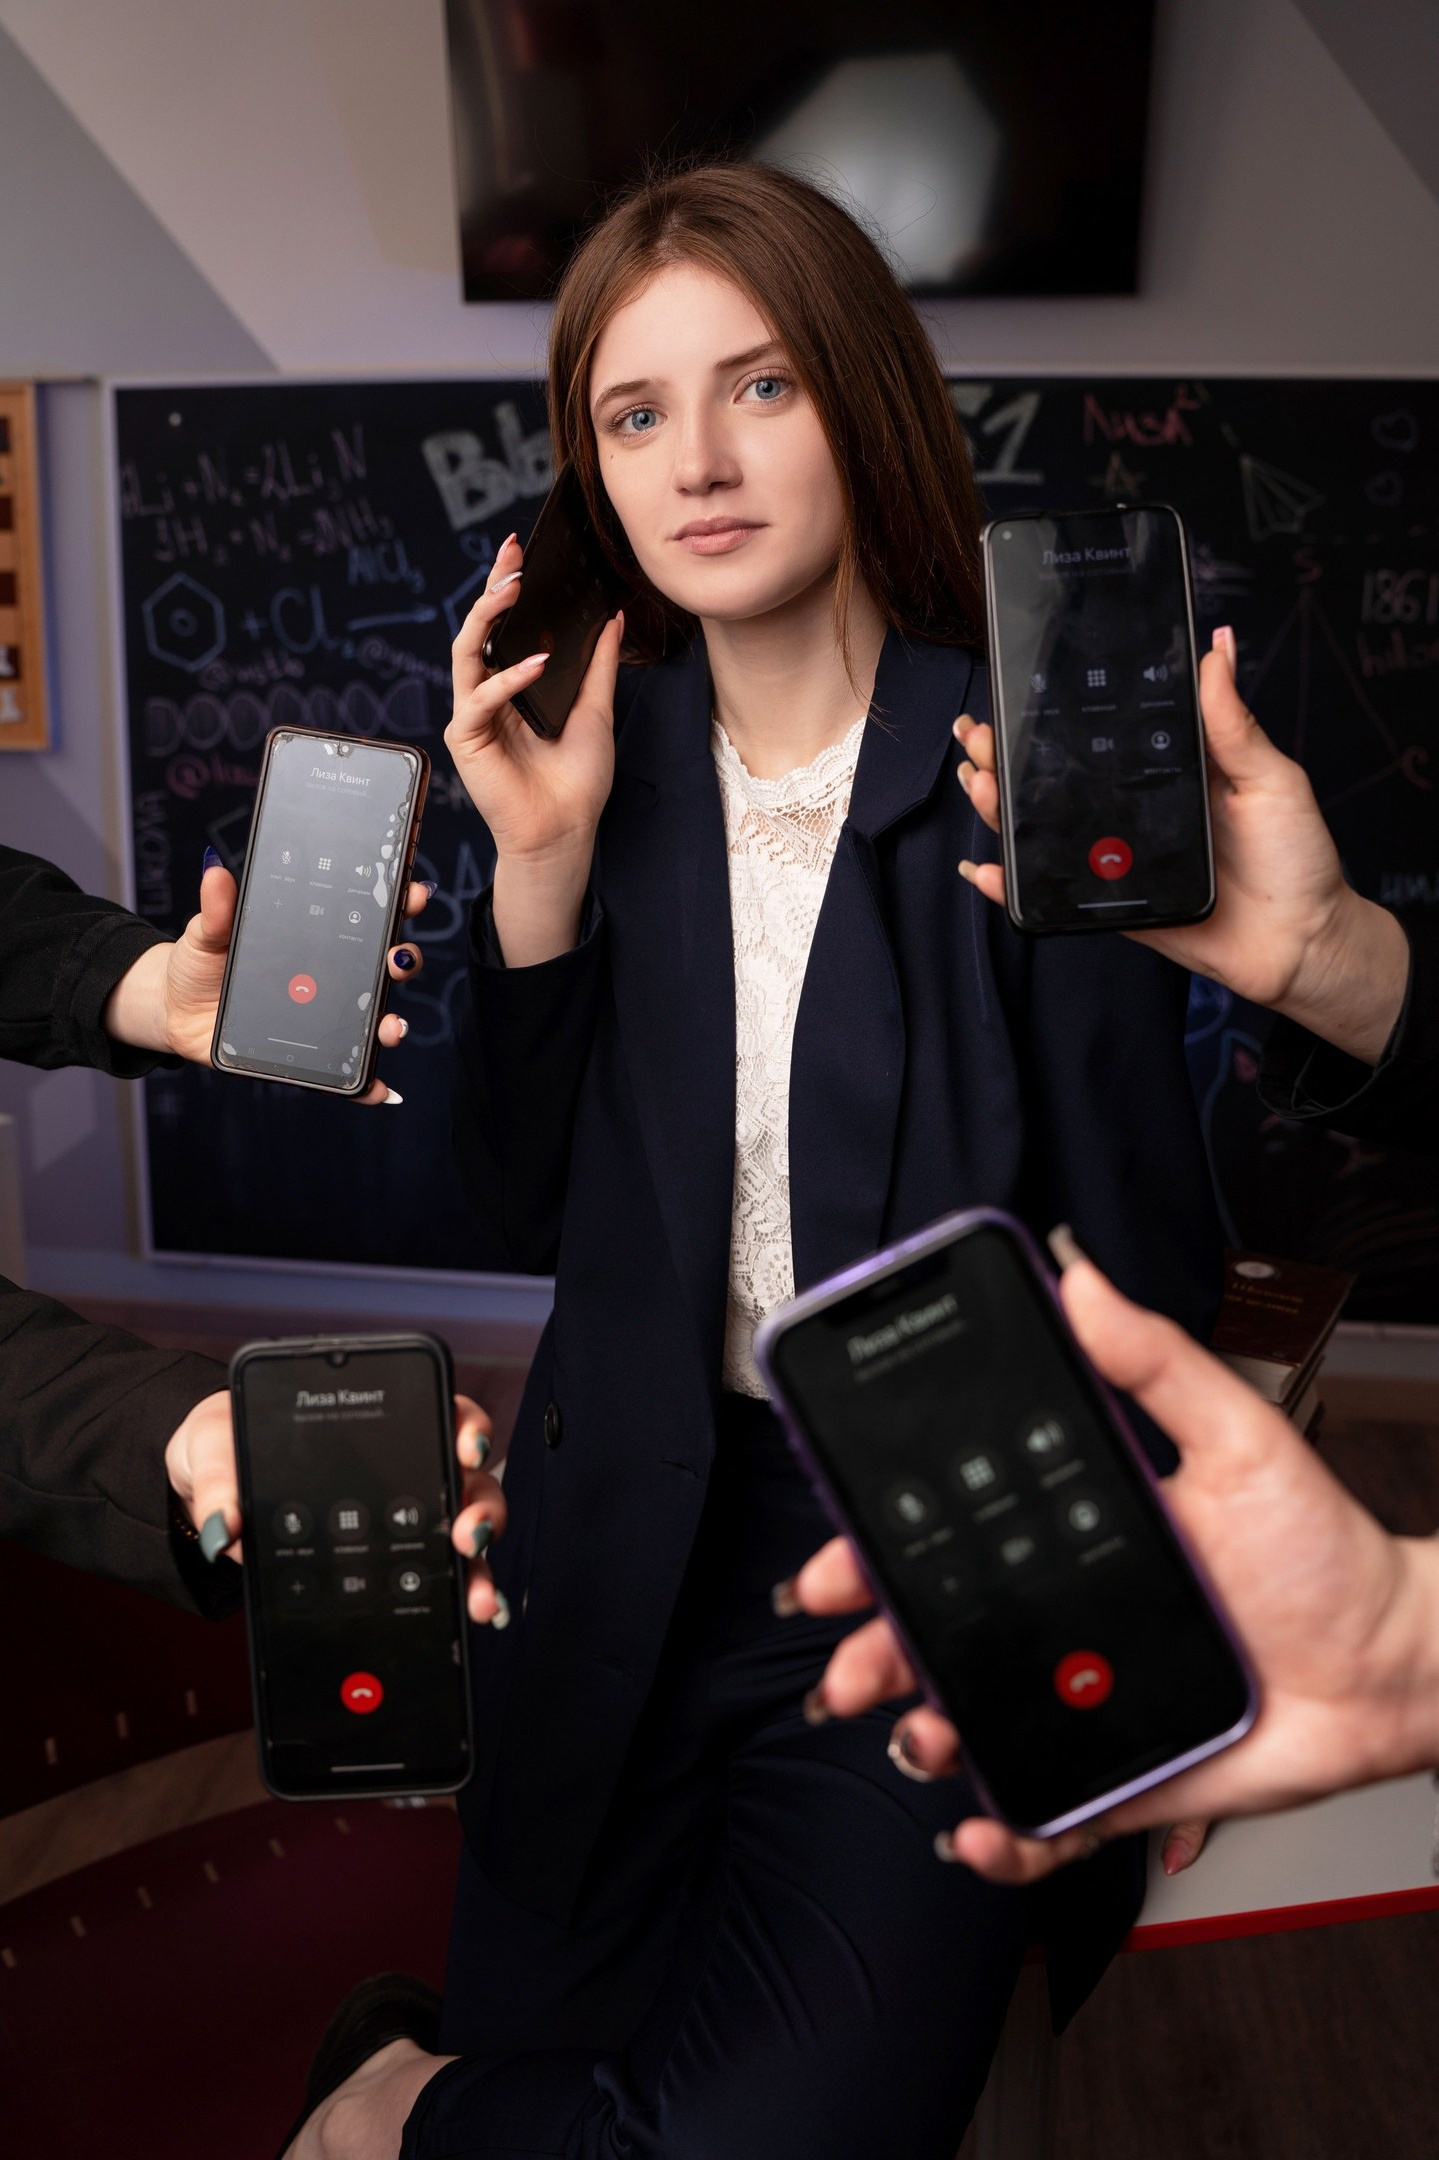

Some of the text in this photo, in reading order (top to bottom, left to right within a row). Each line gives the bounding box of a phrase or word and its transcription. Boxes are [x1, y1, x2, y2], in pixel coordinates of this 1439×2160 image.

[1042, 547, 1131, 565] Лиза Квинт
[310, 767, 371, 787] Лиза Квинт
[296, 1388, 386, 1407] Лиза Квинт
